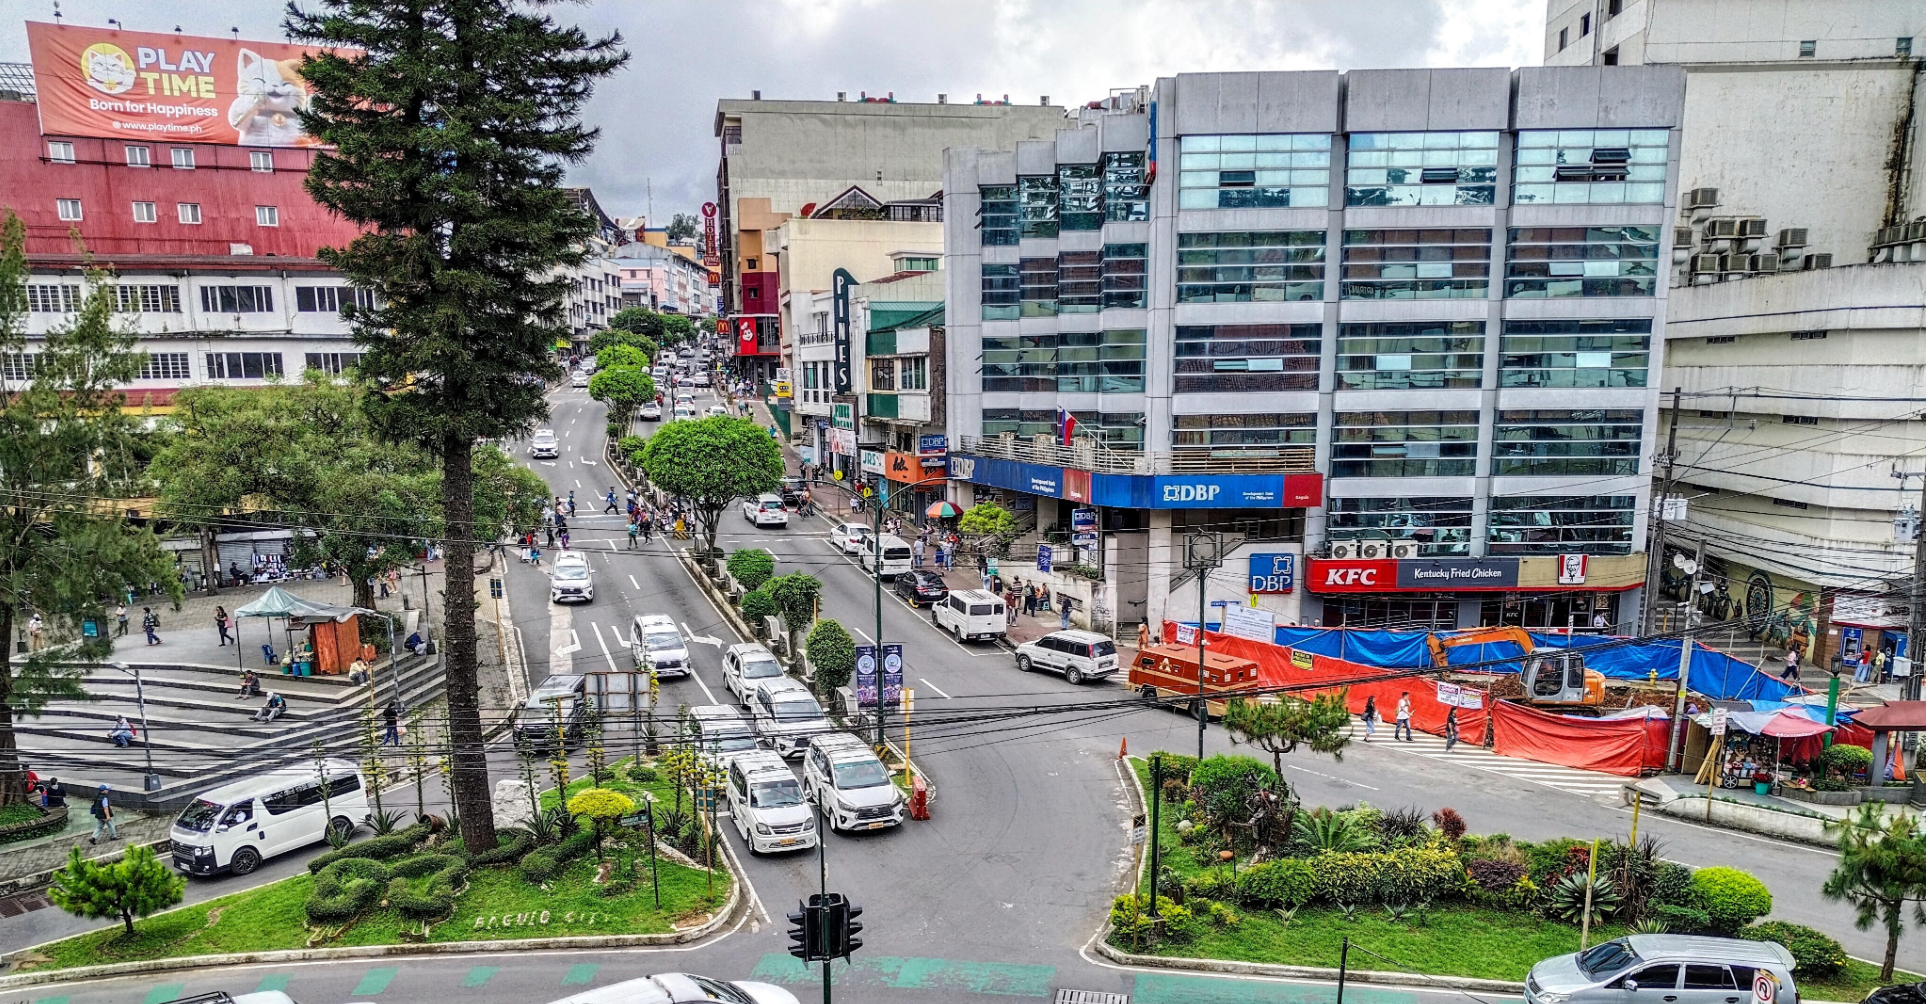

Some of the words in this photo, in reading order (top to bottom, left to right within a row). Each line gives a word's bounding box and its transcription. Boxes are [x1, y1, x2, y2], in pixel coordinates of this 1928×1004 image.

[137, 46, 215, 73] PLAY
[140, 72, 216, 98] TIME
[89, 99, 124, 112] Born
[125, 101, 145, 113] for
[147, 103, 218, 118] Happiness
[122, 121, 203, 134] www.playtime.ph
[706, 219, 715, 254] HOTEL
[836, 275, 848, 386] PINES
[928, 437, 944, 446] DBP
[863, 451, 877, 466] JRS
[1180, 484, 1220, 501] DBP
[1325, 568, 1377, 586] KFC
[1414, 568, 1450, 580] Kentucky
[1451, 568, 1470, 579] Fried
[1471, 568, 1502, 579] Chicken
[1251, 575, 1291, 592] DBP
